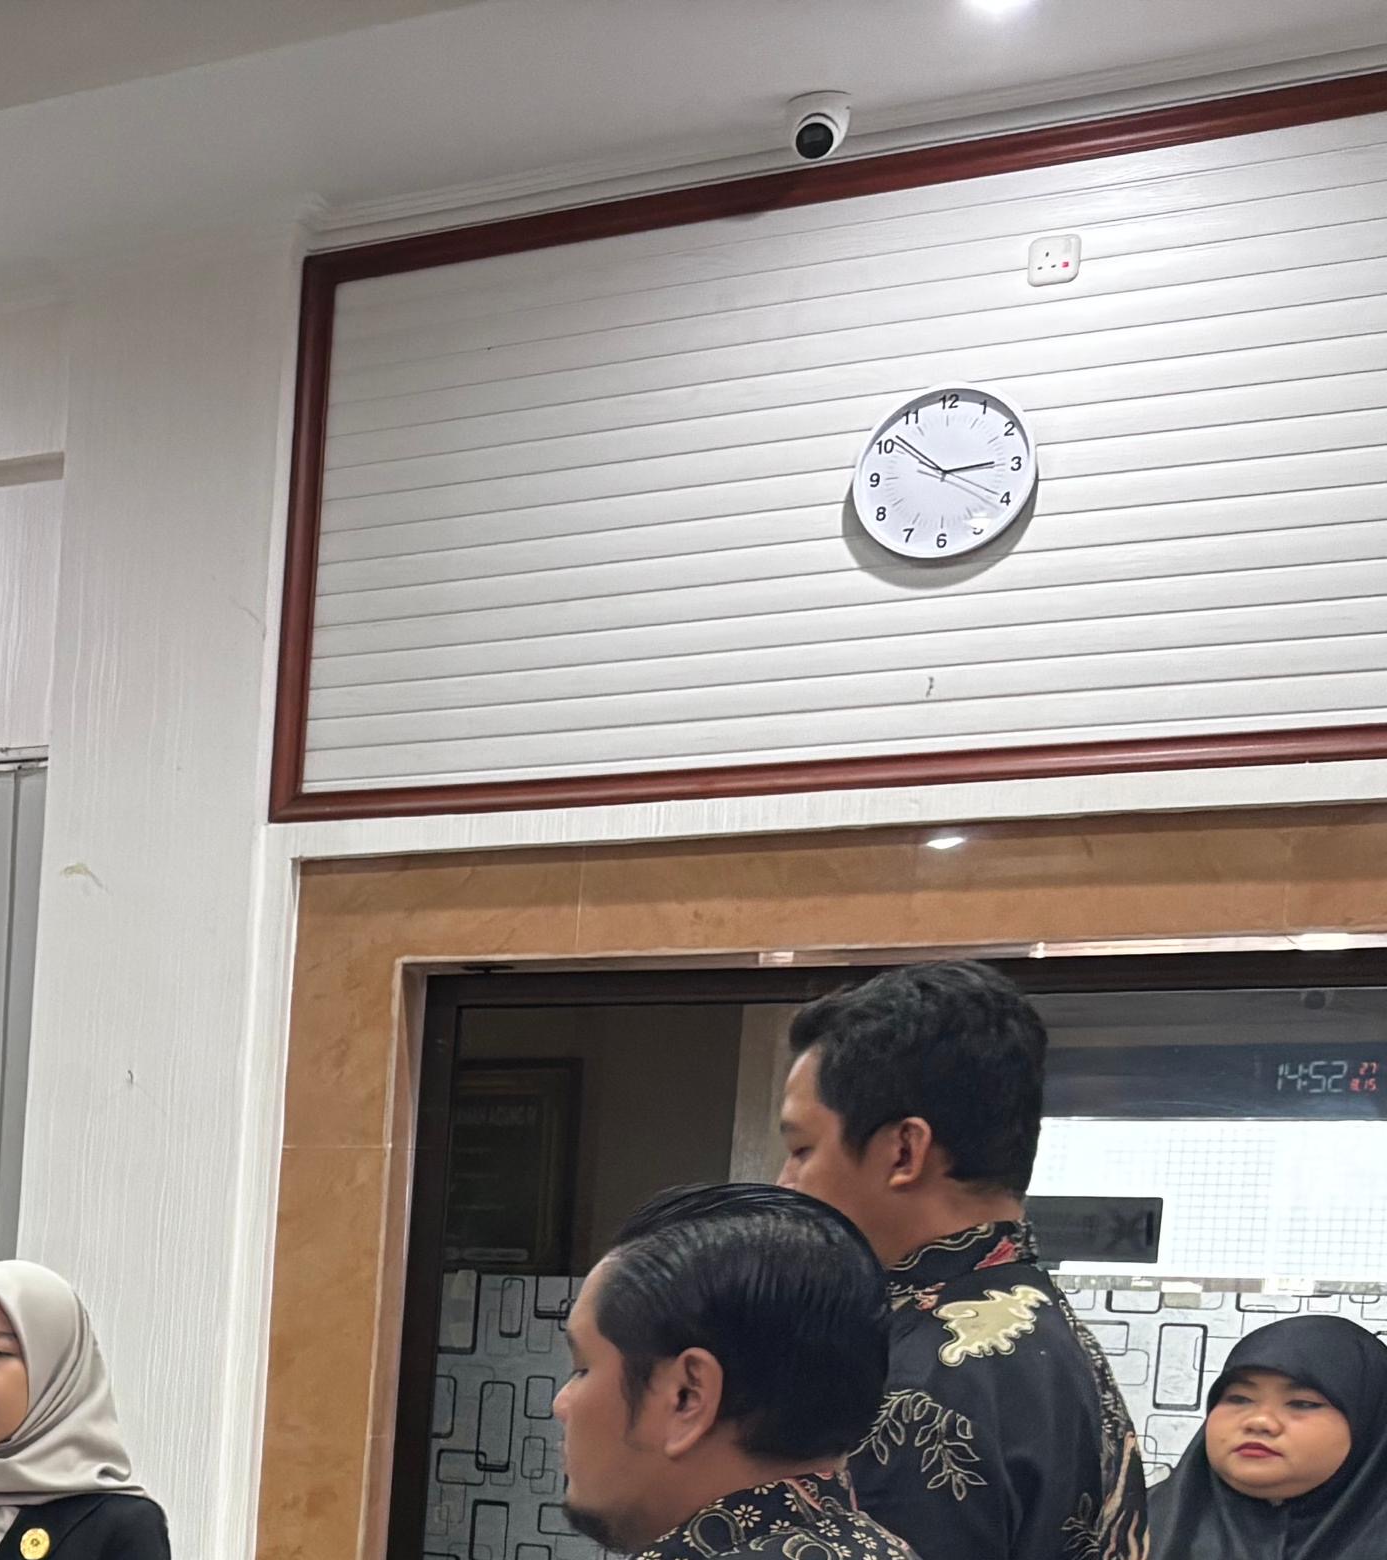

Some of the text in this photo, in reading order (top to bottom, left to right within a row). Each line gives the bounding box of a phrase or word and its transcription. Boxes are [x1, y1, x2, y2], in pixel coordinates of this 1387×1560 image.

[939, 394, 960, 410] 12
[980, 400, 988, 415] 1
[903, 410, 919, 425] 11
[1004, 421, 1016, 437] 2
[877, 439, 895, 455] 10
[1010, 456, 1022, 472] 3
[869, 473, 881, 488] 9
[1000, 491, 1012, 507] 4
[875, 507, 887, 522] 8
[902, 528, 915, 543] 7
[936, 533, 948, 549] 6
[1276, 1060, 1348, 1094] 14:52
